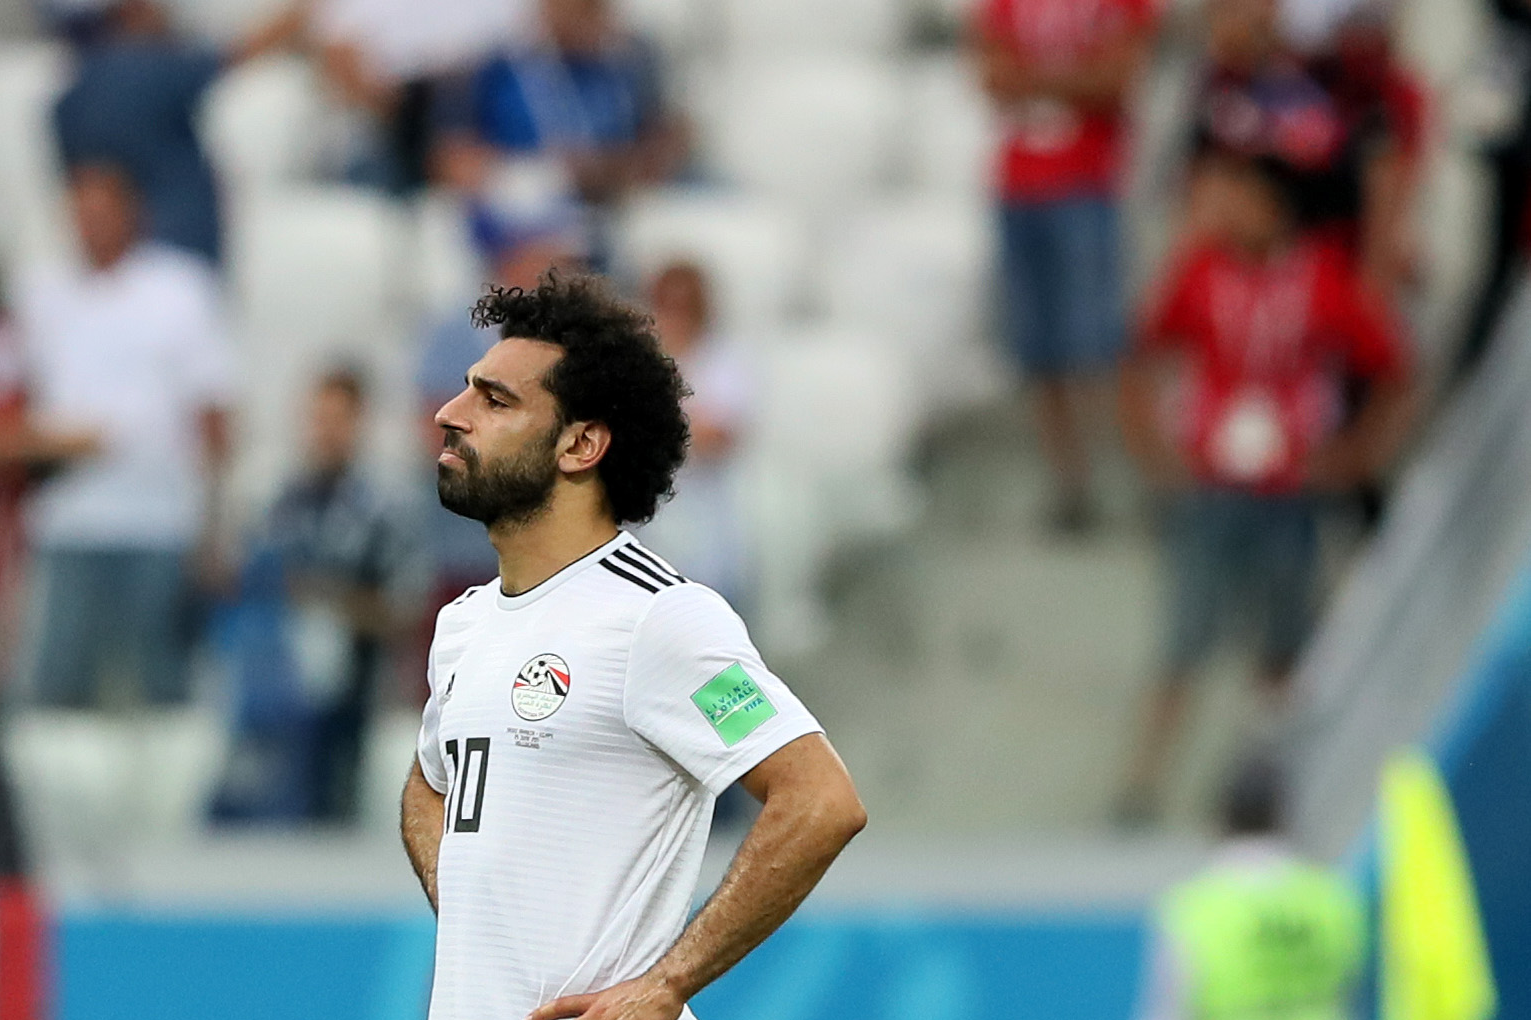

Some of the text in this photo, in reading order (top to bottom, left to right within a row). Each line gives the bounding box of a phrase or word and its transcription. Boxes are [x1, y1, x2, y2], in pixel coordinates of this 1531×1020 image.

[705, 680, 750, 715] LIVING
[744, 697, 764, 713] FIFA
[446, 737, 491, 834] 10
